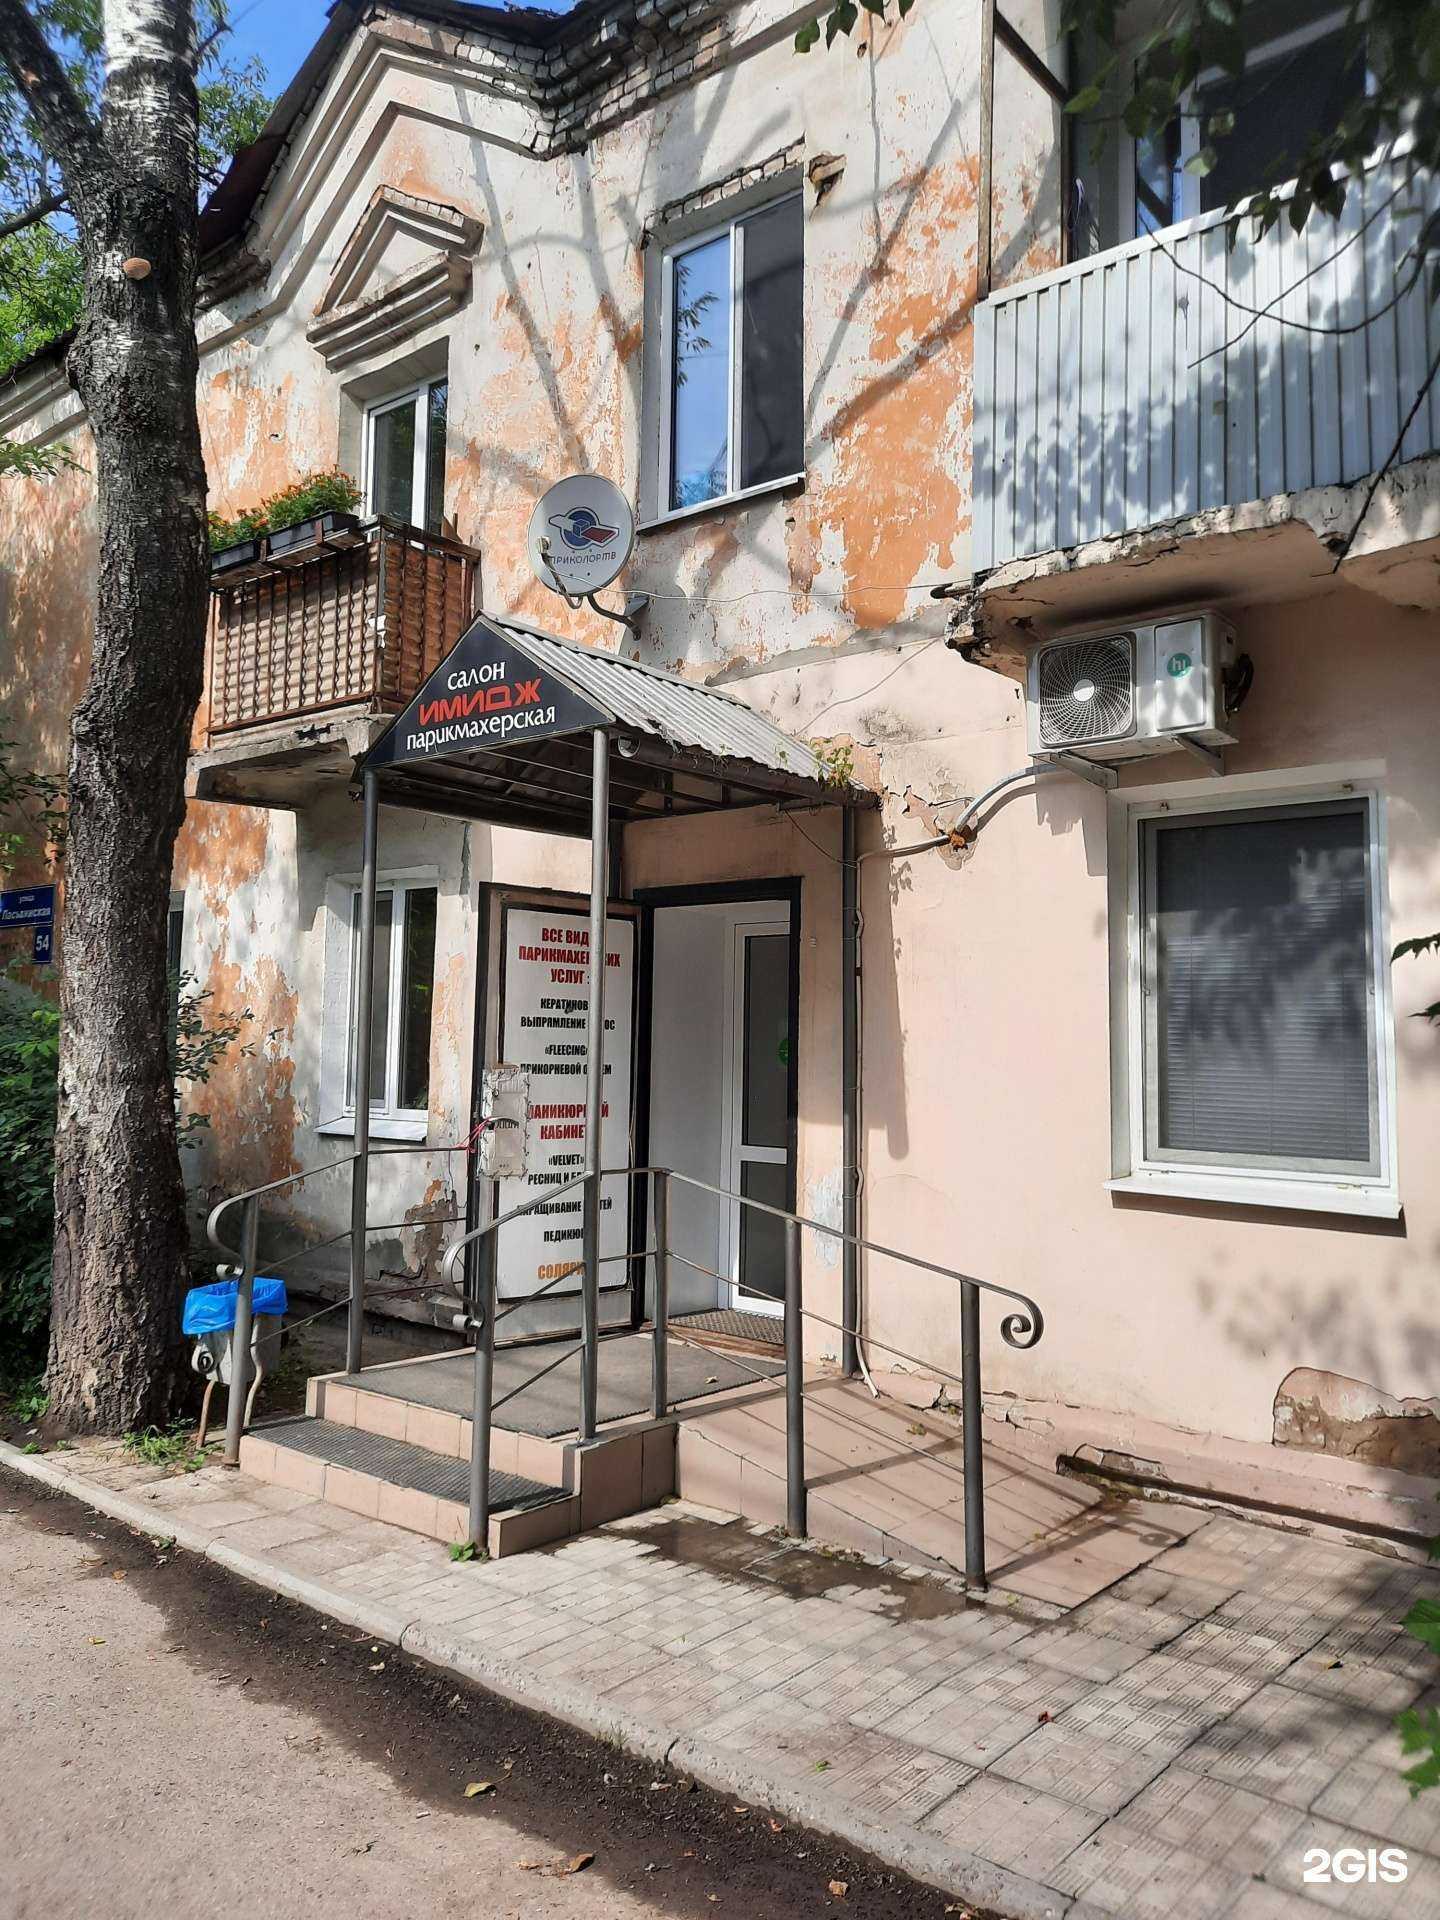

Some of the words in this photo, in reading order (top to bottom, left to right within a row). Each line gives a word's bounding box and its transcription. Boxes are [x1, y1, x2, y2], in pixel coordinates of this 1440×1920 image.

[447, 661, 506, 691] салон
[418, 678, 542, 726] ИМИДЖ
[406, 706, 555, 753] парикмахерская
[35, 935, 50, 951] 54
[541, 927, 563, 943] ВСЕ
[566, 930, 590, 947] ВИД
[518, 946, 621, 968] ПАРИКМАХЕИХ
[550, 968, 585, 984] УСЛУГ
[540, 998, 589, 1011] КЕРАТИНОВ
[520, 1016, 586, 1029] ВЫПРЯМЛЕНИЕ
[520, 1062, 581, 1075] ПРИКОРНЕВОЙ
[540, 1124, 586, 1140] КАБИНЕ
[528, 1172, 562, 1186] РЕСНИЦ
